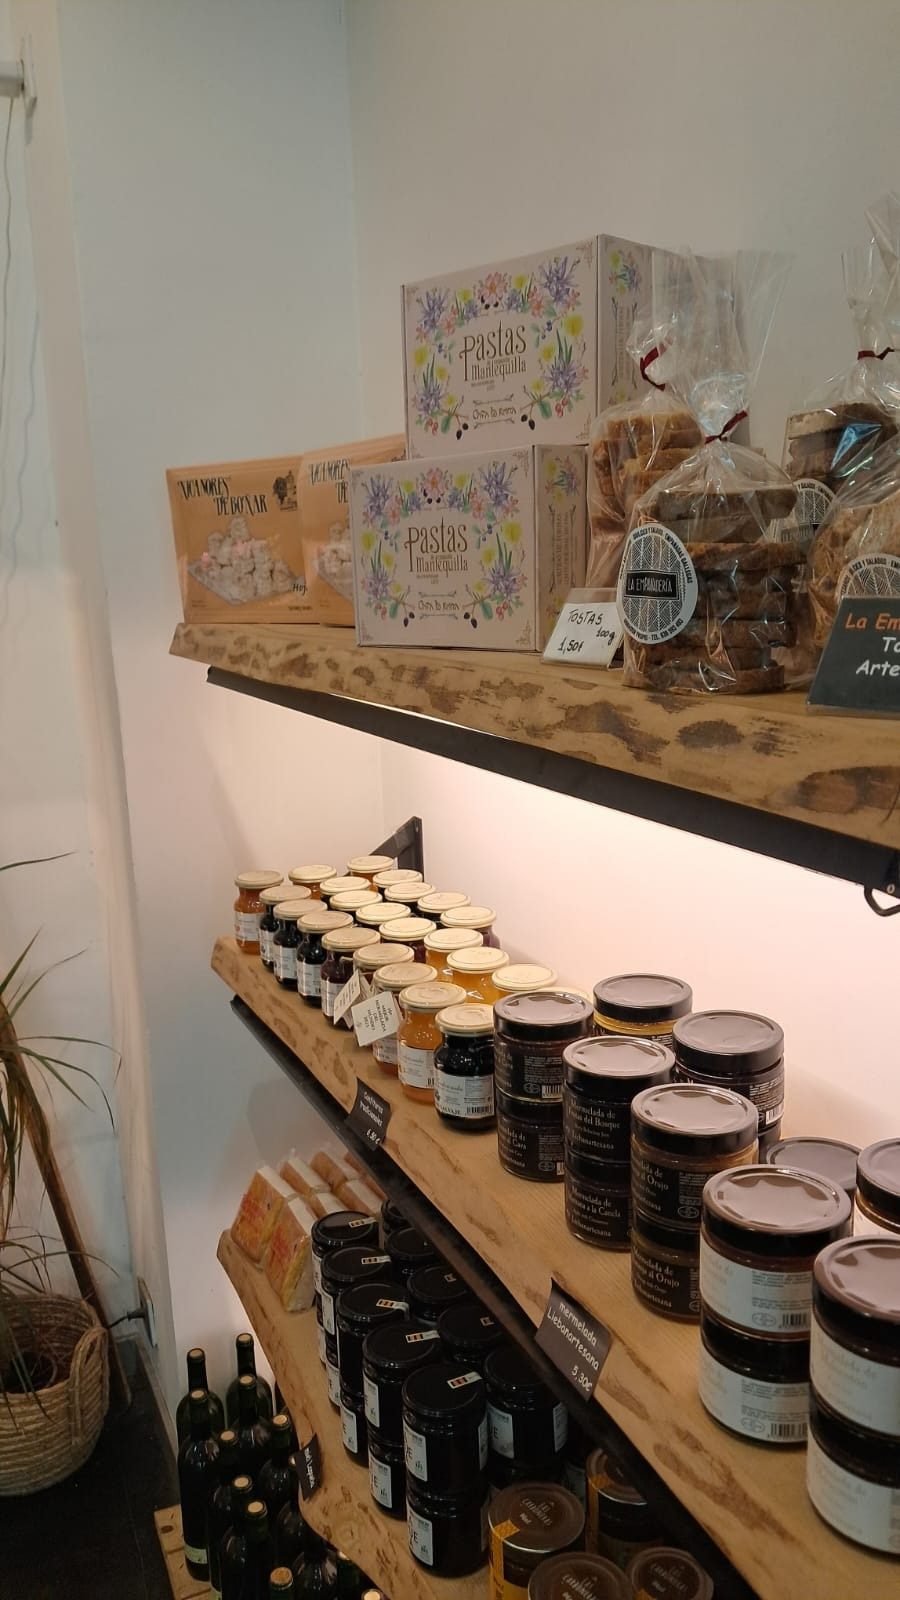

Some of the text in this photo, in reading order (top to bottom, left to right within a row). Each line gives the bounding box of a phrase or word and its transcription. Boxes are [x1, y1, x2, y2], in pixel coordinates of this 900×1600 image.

[459, 320, 527, 382] Pastas
[404, 516, 468, 572] Pastas
[628, 578, 634, 591] LA
[568, 609, 603, 626] TOSTAS
[845, 613, 867, 630] La
[547, 1308, 599, 1371] Liebanartesana
[559, 1301, 597, 1347] mermelada
[571, 1365, 593, 1392] 5,30€
